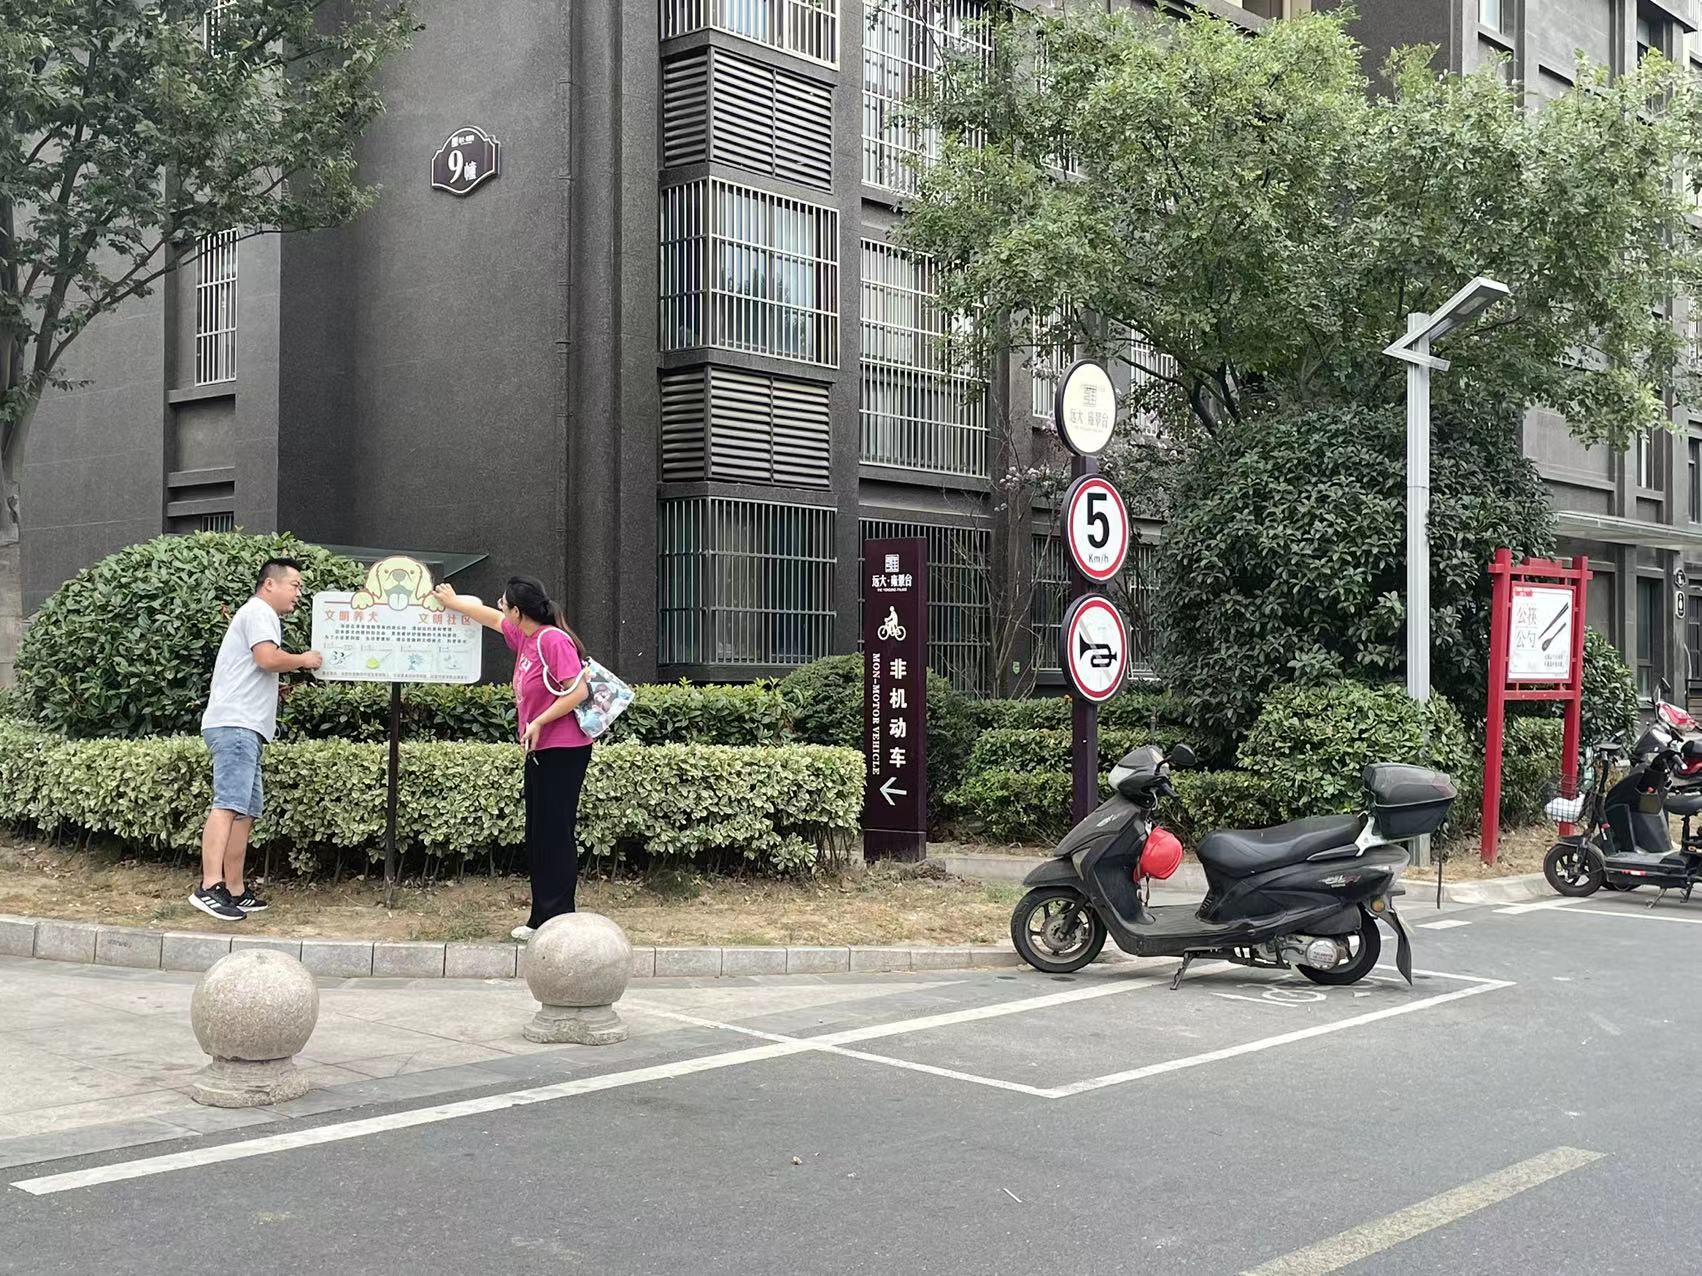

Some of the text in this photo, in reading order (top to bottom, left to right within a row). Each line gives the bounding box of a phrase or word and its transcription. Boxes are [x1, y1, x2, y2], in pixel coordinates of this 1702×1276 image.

[1087, 493, 1110, 548] 5
[1088, 554, 1109, 563] Km/h
[324, 609, 471, 625] 文明养犬 文明社区
[1517, 606, 1537, 625] 公筷
[1516, 630, 1536, 648] 公勺
[889, 658, 908, 768] 非机动车
[872, 726, 881, 775] VEHICLE
